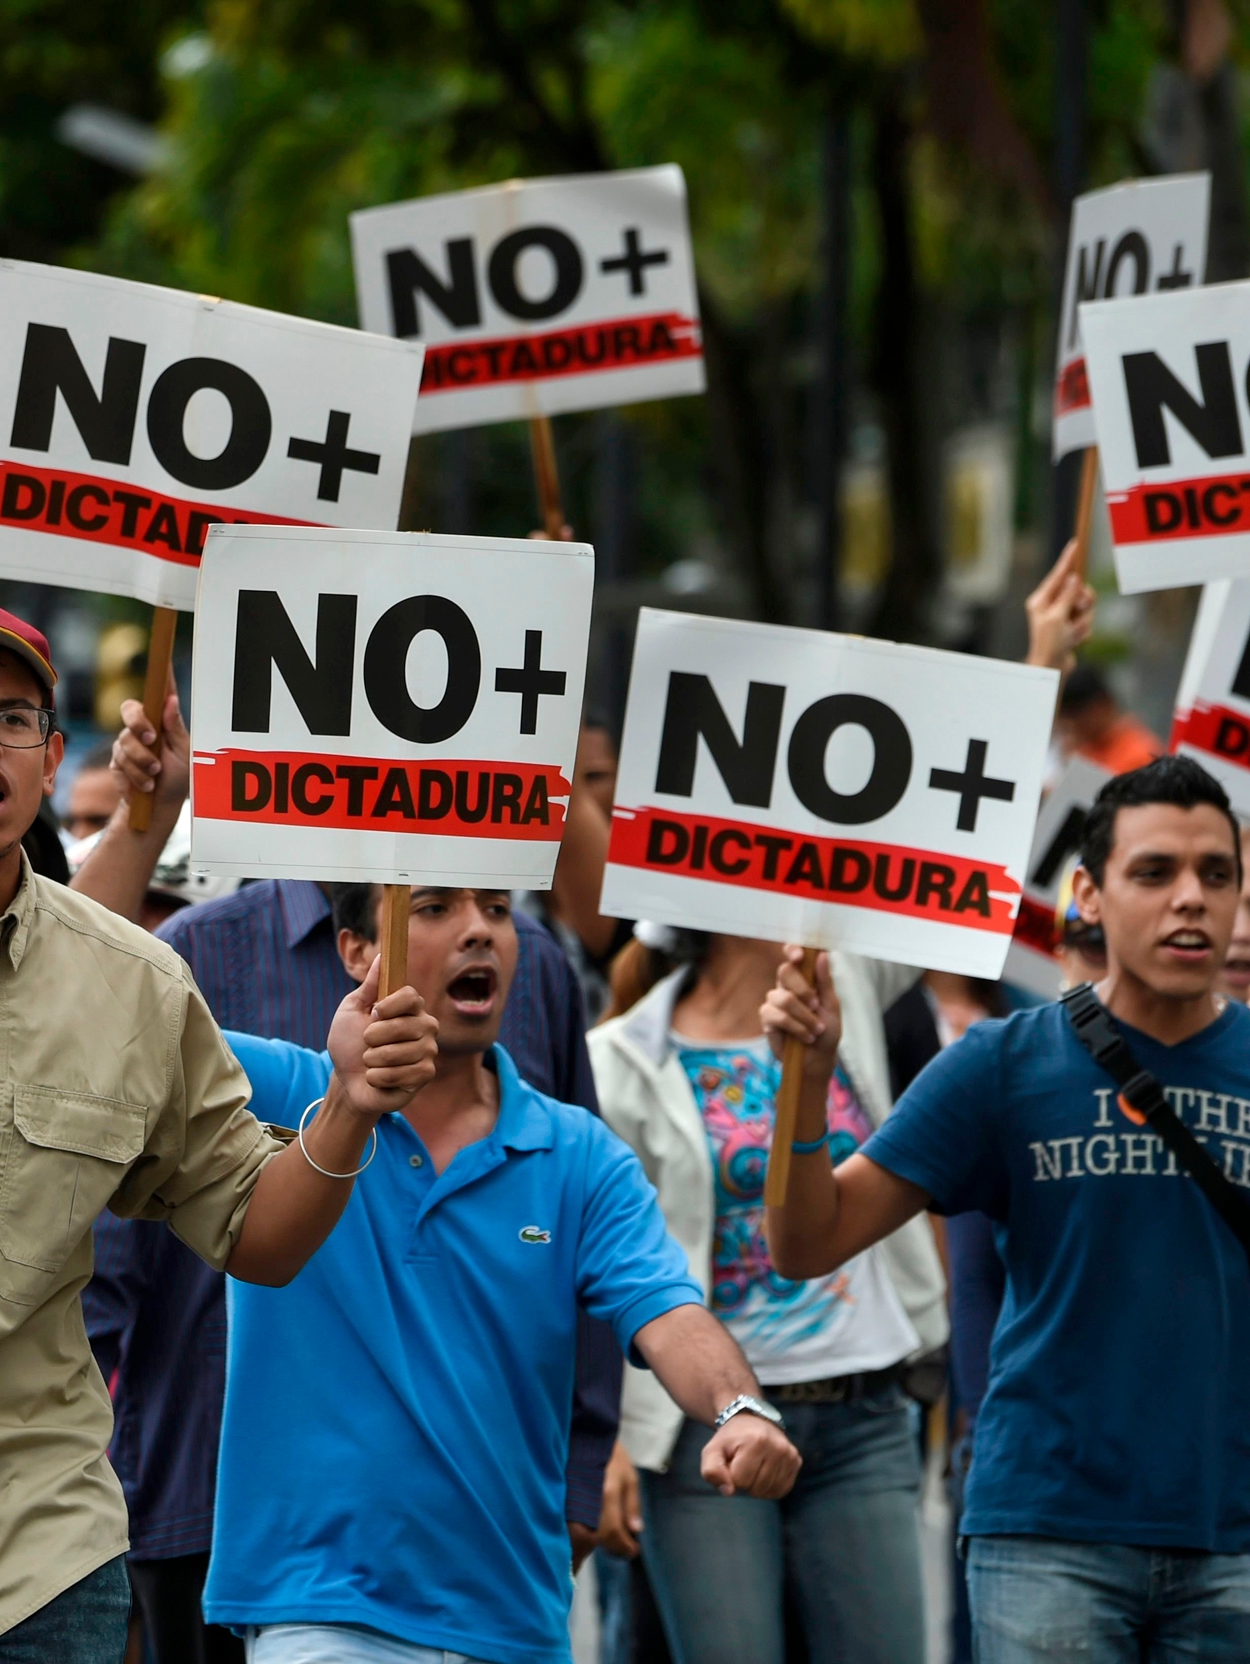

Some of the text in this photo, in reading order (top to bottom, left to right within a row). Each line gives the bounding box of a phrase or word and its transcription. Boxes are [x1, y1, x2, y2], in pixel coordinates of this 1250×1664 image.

[421, 328, 678, 386] ICTADURA
[231, 760, 550, 826] DICTADURA
[645, 817, 993, 918] DICTADURA
